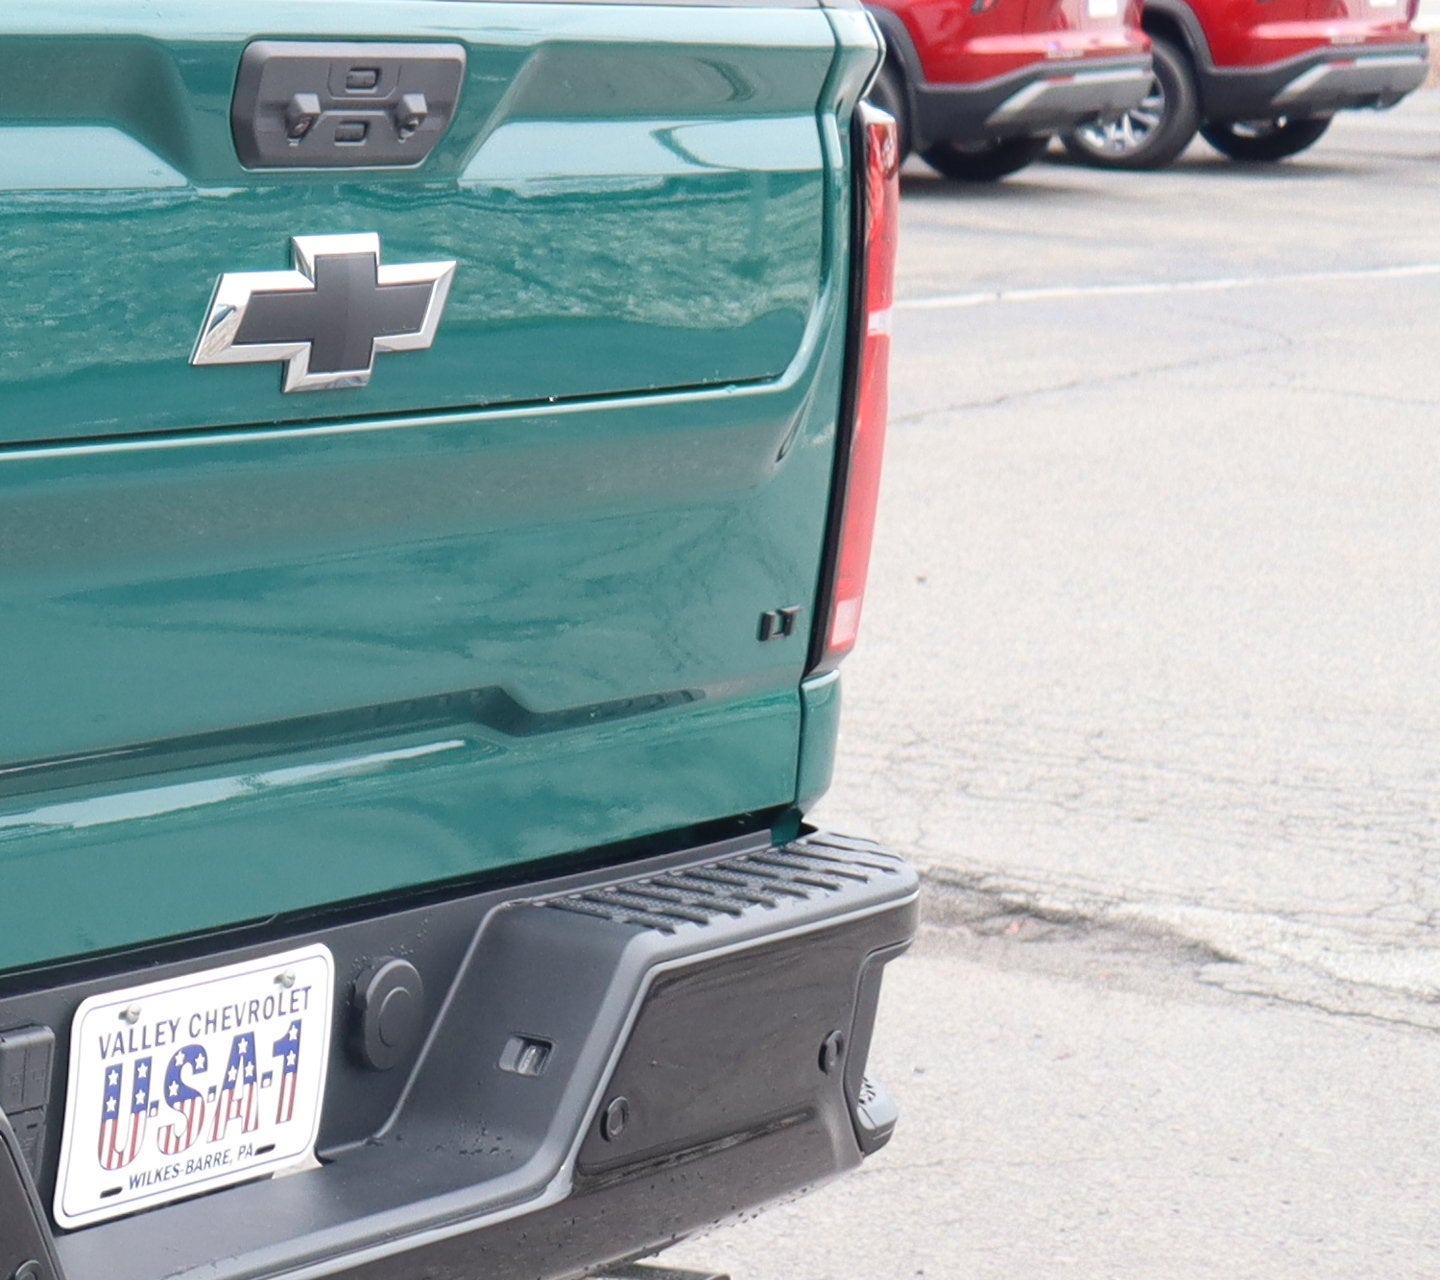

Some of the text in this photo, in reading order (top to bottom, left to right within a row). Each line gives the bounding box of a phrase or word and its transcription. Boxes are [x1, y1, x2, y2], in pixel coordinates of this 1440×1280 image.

[757, 604, 803, 642] LT
[97, 984, 313, 1061] VALLEY CHEVROLET
[237, 1142, 255, 1162] PA
